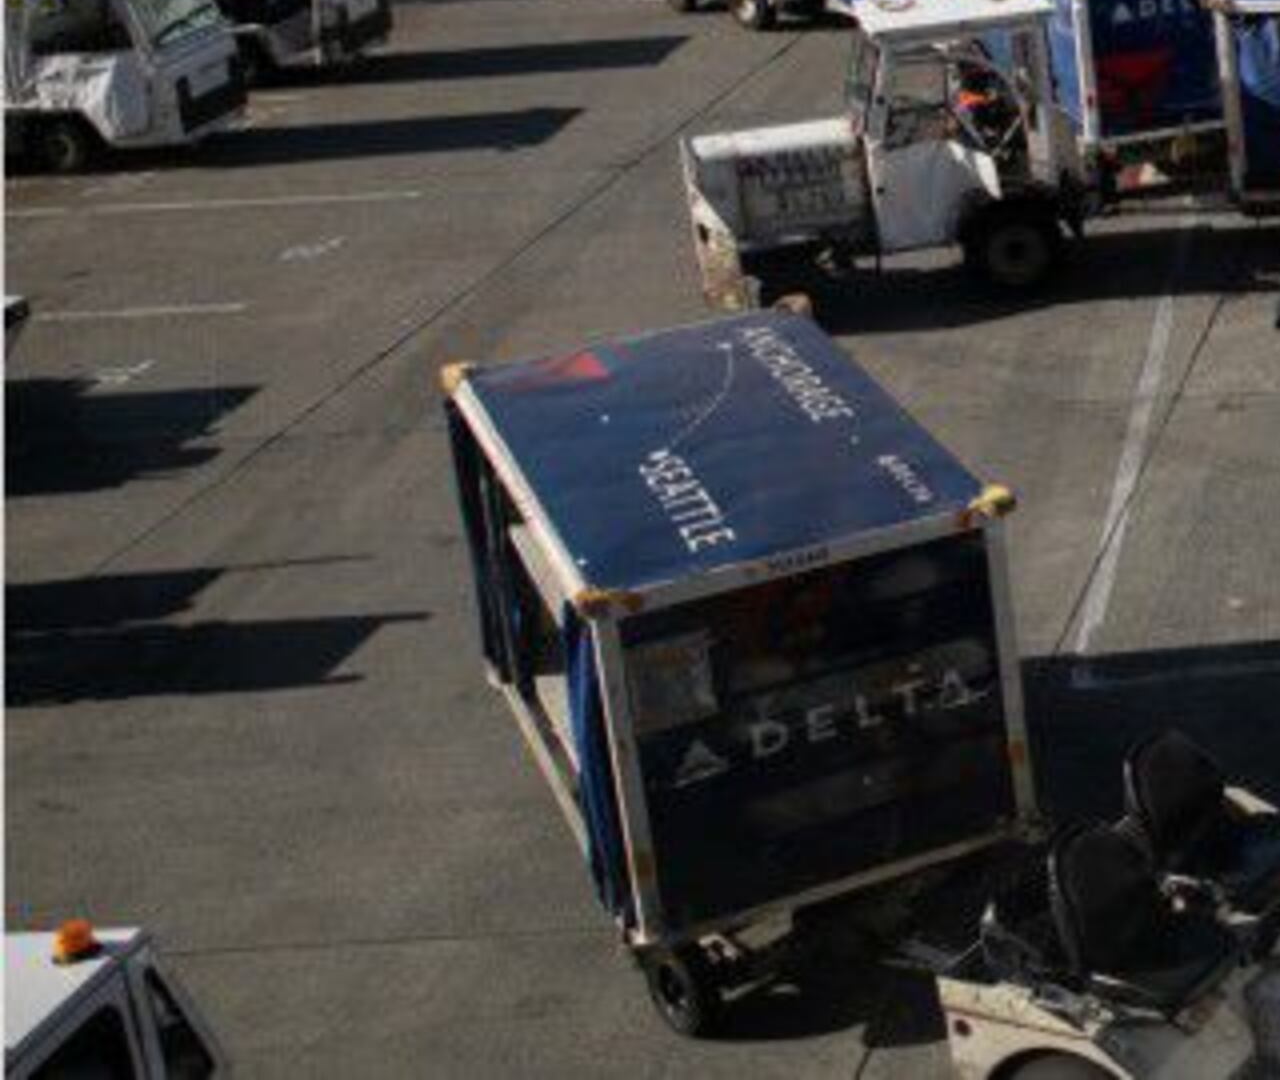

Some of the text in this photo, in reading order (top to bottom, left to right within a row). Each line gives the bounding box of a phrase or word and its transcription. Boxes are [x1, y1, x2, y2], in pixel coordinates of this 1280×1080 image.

[740, 325, 856, 423] ANCHORAGE
[638, 455, 736, 553] SEATTLE
[752, 669, 990, 757] DELTA
